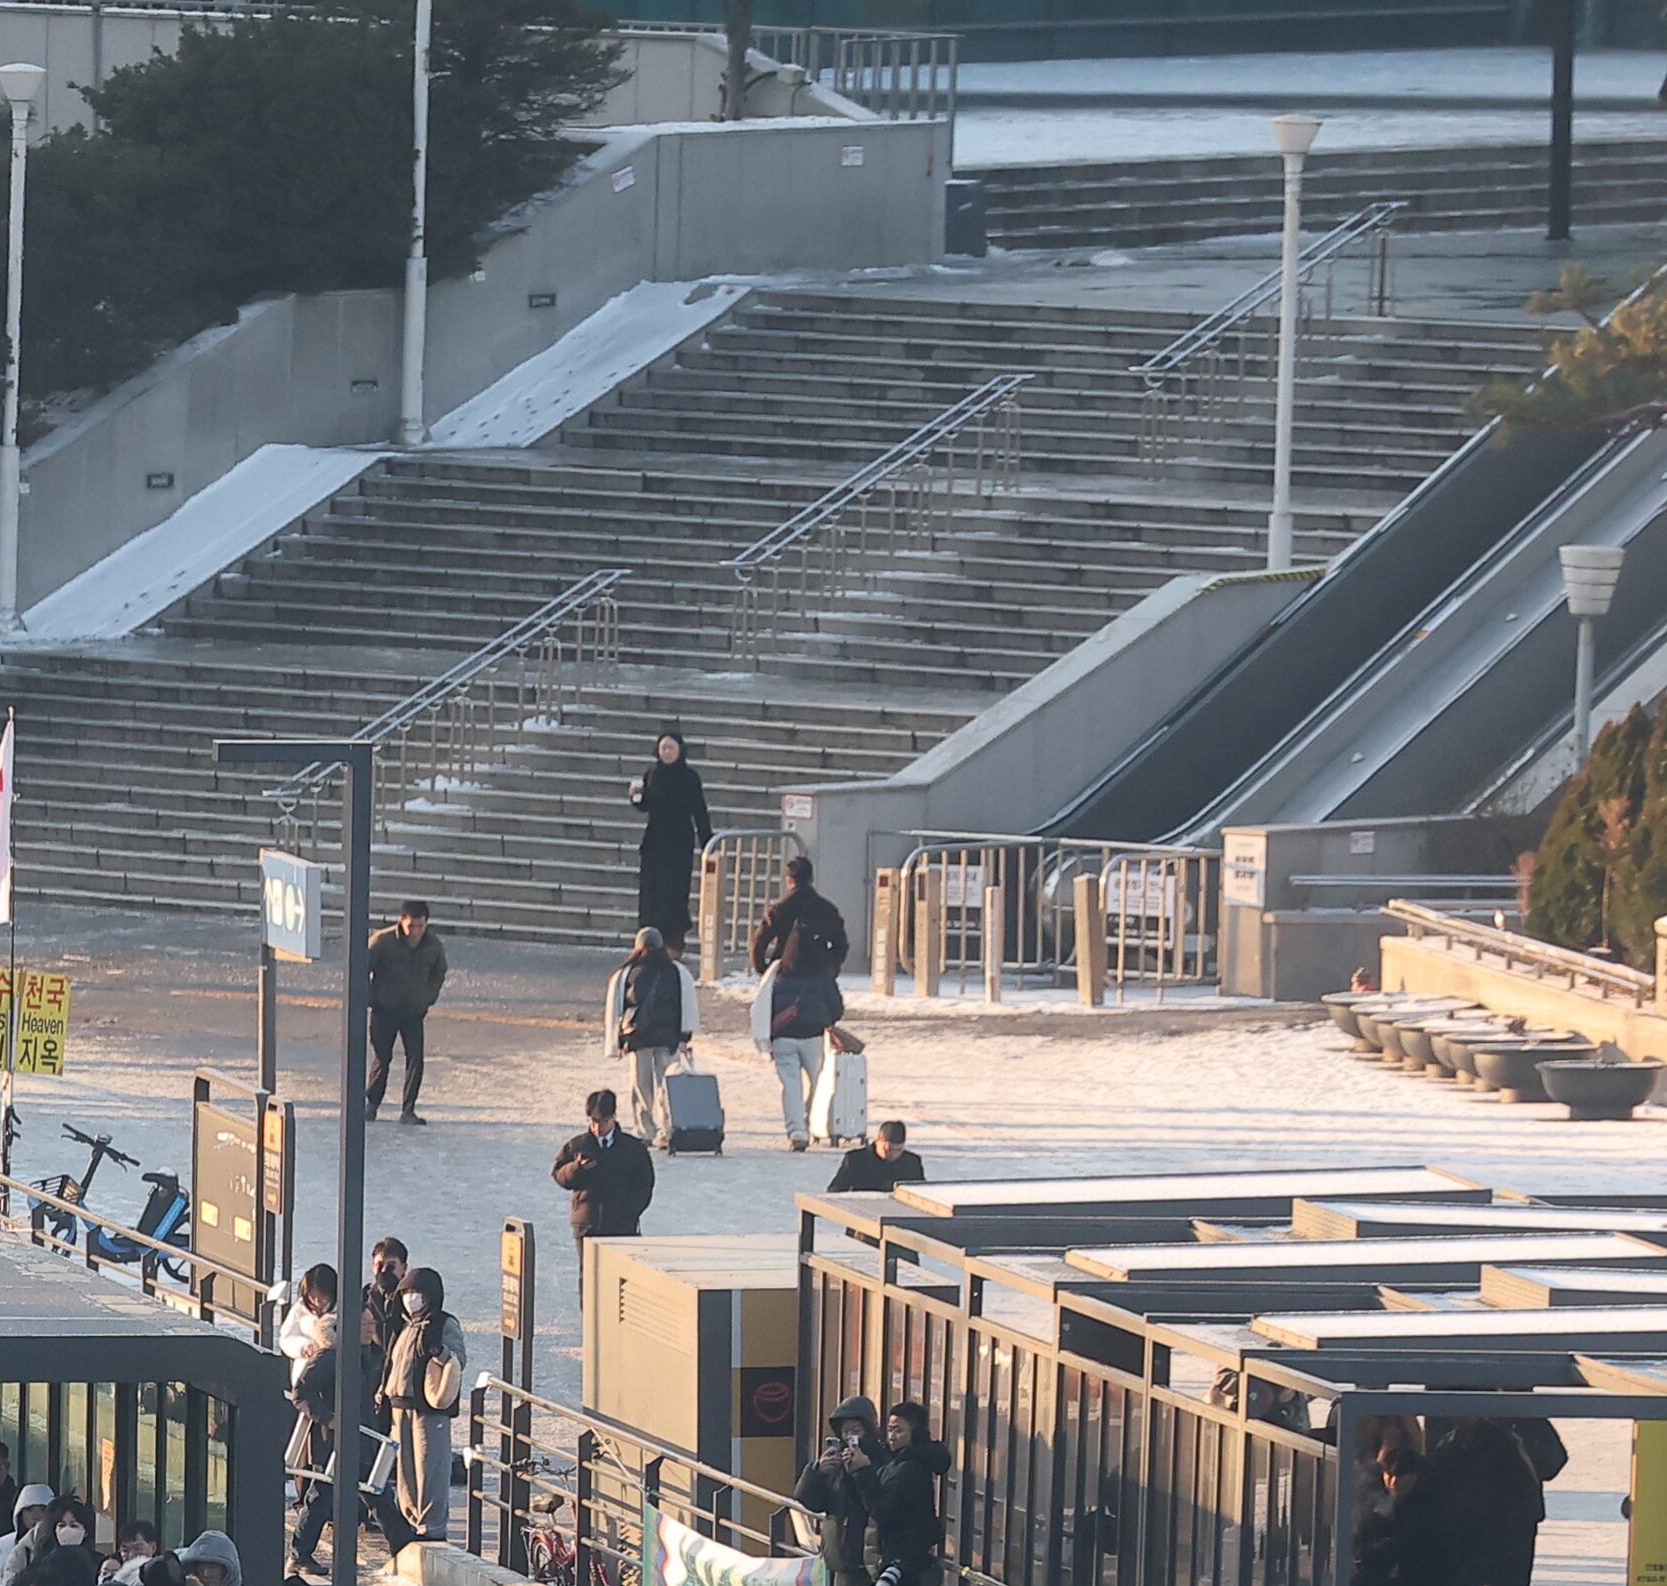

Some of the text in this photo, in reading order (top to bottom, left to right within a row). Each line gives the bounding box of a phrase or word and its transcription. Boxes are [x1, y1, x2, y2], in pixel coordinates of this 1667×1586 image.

[25, 976, 66, 1013] 천국
[21, 1011, 64, 1035] Heaven
[19, 1036, 59, 1075] 지옥
